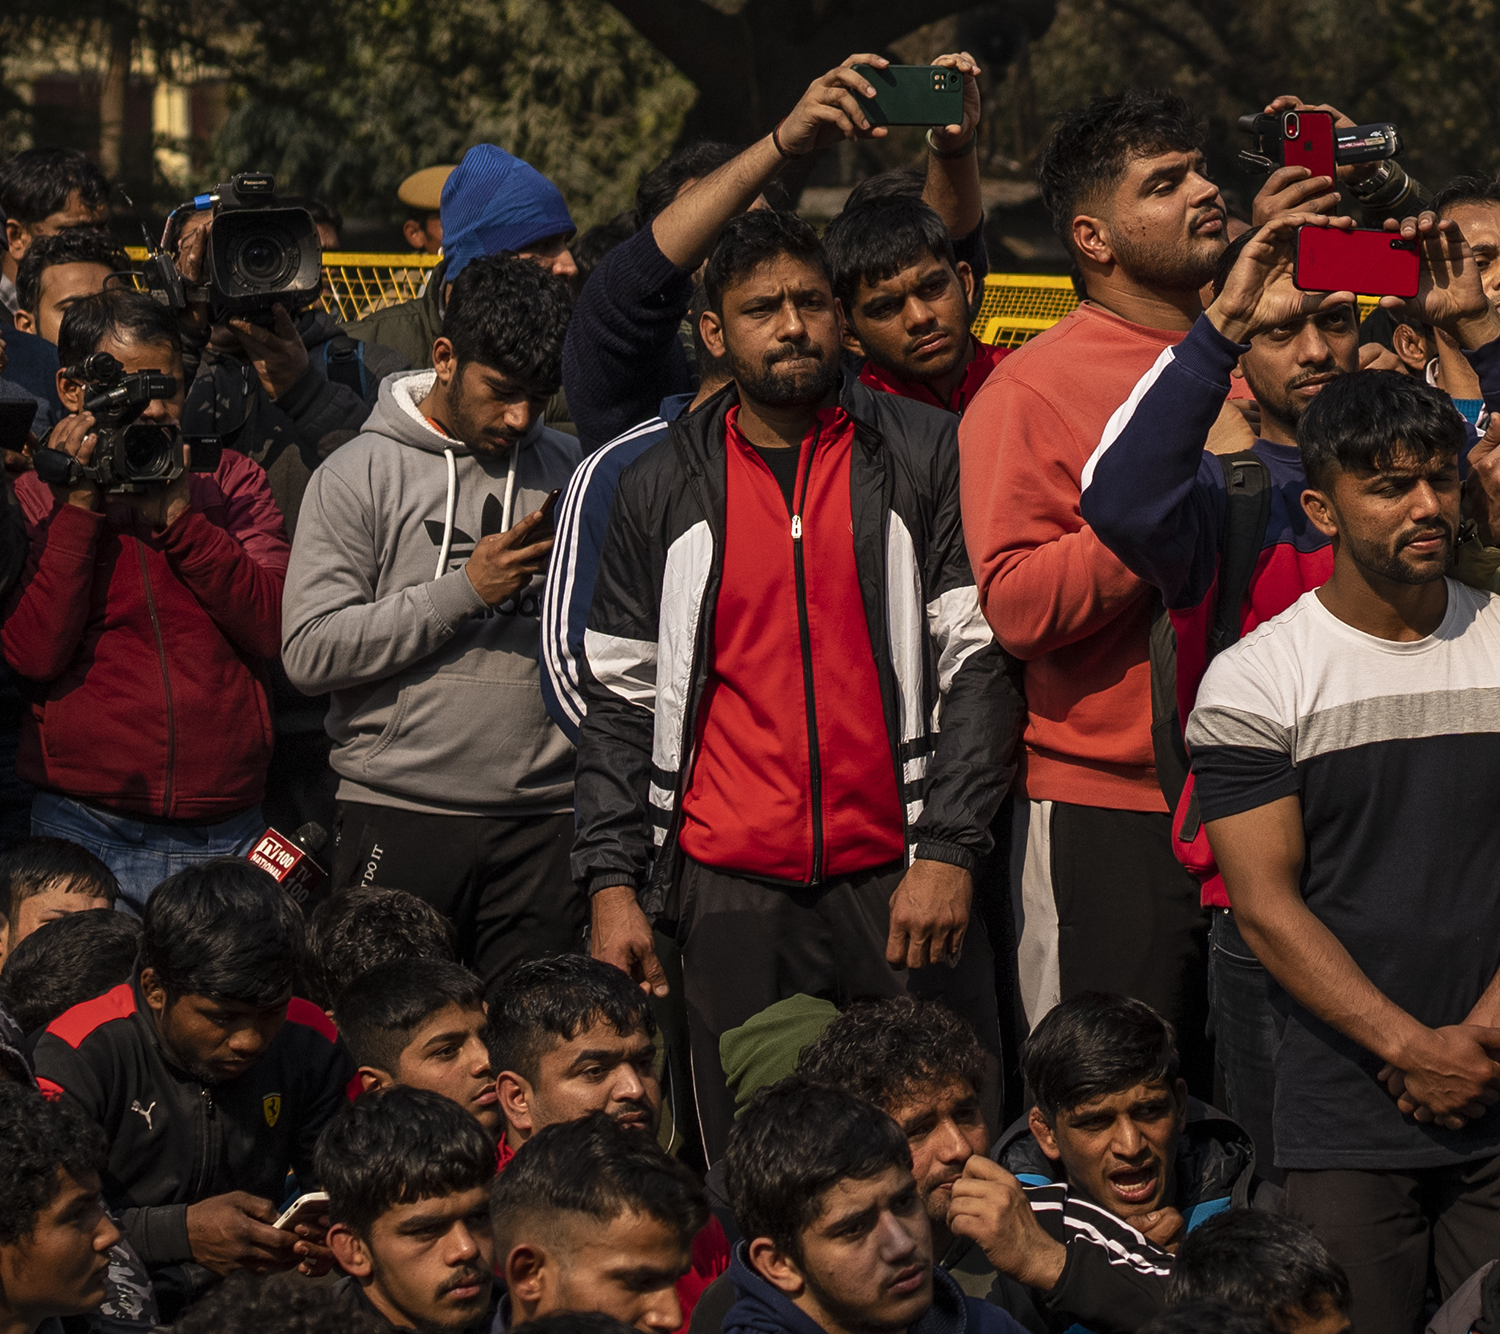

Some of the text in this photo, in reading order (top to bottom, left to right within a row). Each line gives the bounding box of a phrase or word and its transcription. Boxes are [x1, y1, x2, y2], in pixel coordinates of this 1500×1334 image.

[277, 843, 297, 870] 100
[370, 844, 385, 861] IT
[250, 853, 285, 881] NATIONAL
[363, 861, 378, 882] DO
